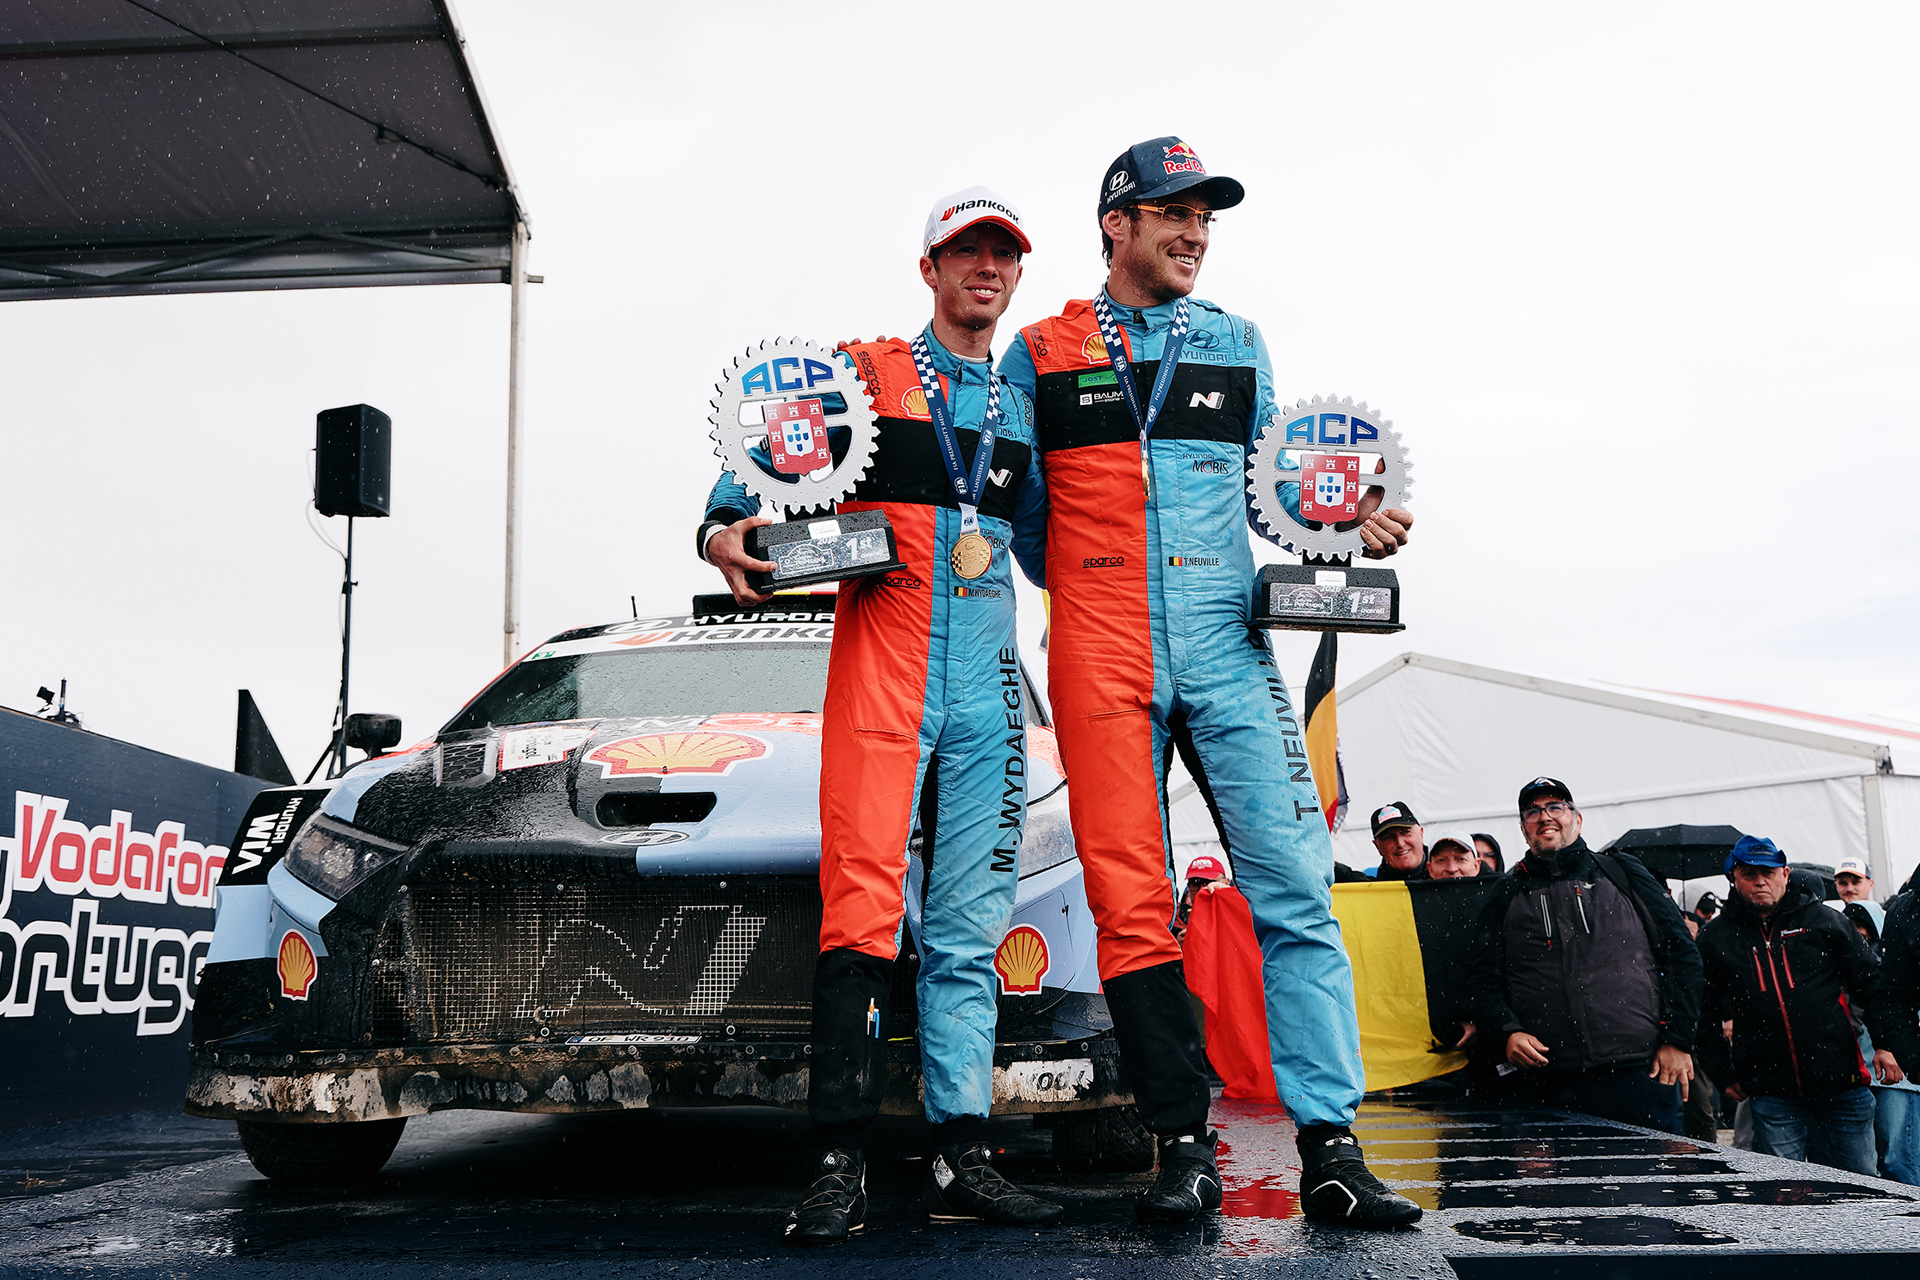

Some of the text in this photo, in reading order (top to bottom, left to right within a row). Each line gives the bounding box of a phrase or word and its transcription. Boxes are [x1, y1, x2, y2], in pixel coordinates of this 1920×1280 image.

[1163, 159, 1193, 174] Red
[1107, 180, 1136, 205] HYUNDAI
[1115, 356, 1126, 371] FIA
[1179, 350, 1228, 362] YUNDAI
[741, 357, 834, 395] ACP
[856, 350, 882, 397] sparco
[1286, 413, 1379, 447] ACP
[1192, 460, 1229, 475] MOBIS
[984, 536, 1006, 551] OBIS
[1082, 556, 1124, 568] sparco
[1184, 557, 1219, 566] T.NEUVILLE
[885, 576, 921, 590] parco
[1349, 591, 1375, 613] 1st
[990, 647, 1025, 873] M. WYDAEGHE
[271, 797, 303, 844] HYUNDAI
